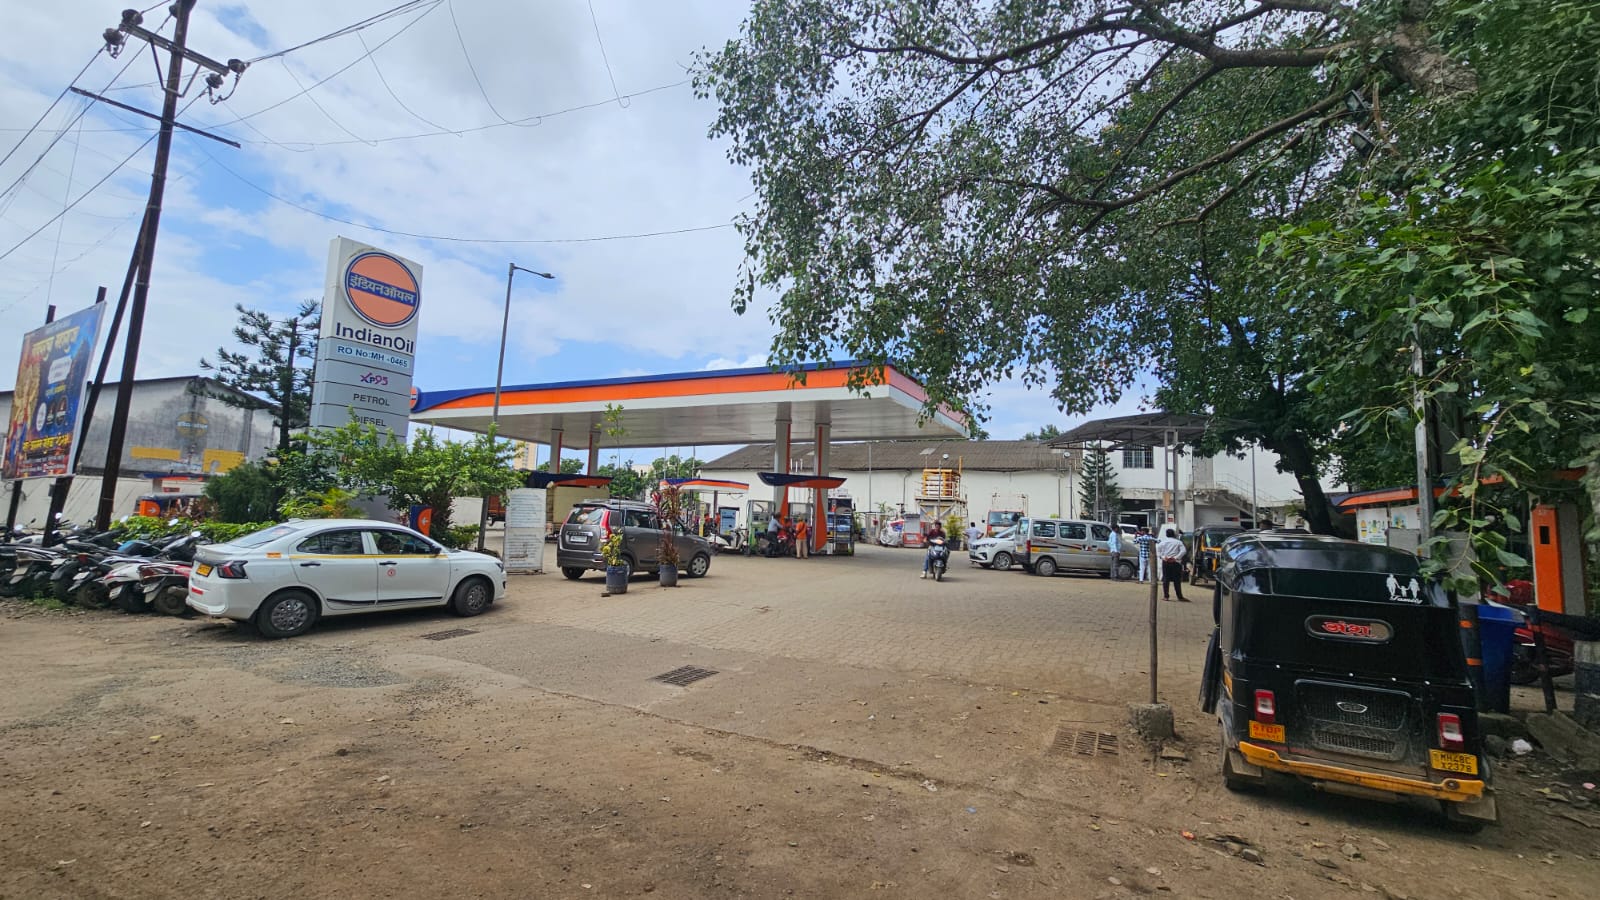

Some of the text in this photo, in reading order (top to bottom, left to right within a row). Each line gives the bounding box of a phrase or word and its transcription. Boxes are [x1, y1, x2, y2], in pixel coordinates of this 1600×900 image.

[335, 322, 414, 354] IndianOil
[337, 345, 353, 355] RO
[353, 393, 390, 406] PETROL
[1253, 723, 1282, 733] STOP
